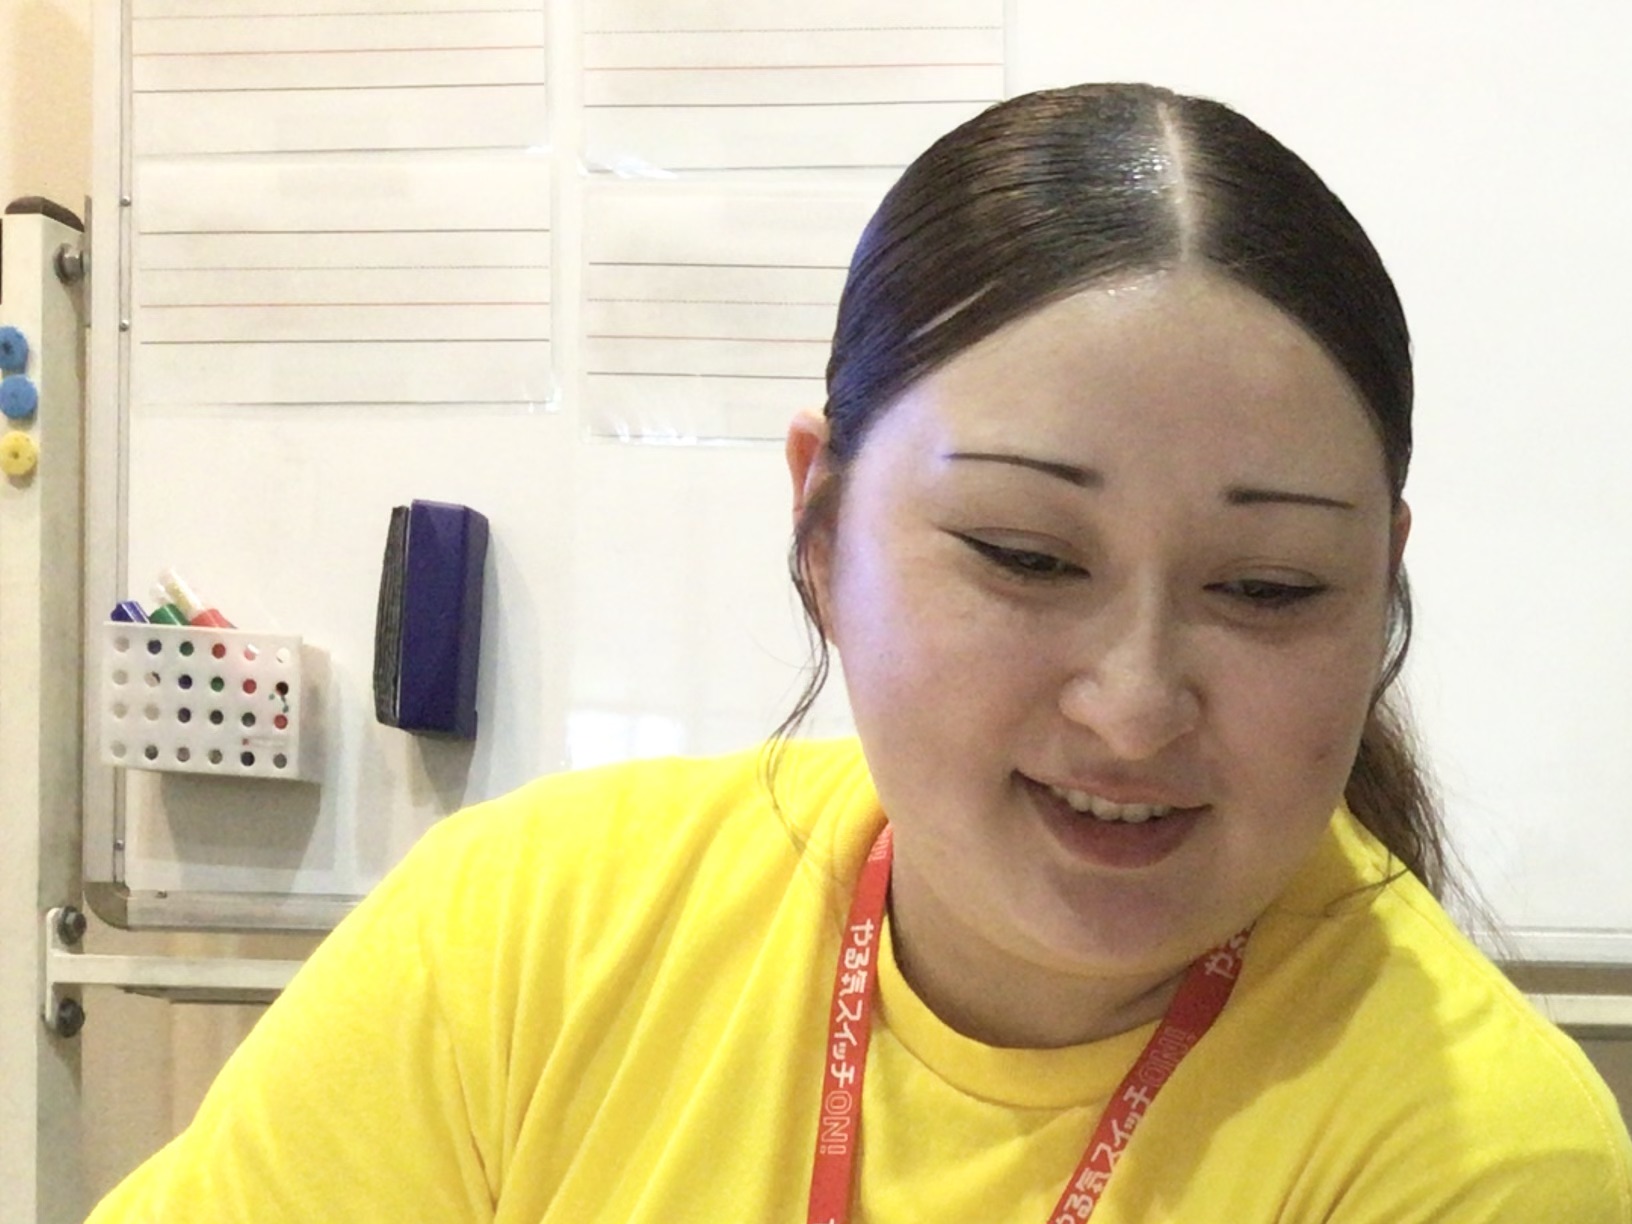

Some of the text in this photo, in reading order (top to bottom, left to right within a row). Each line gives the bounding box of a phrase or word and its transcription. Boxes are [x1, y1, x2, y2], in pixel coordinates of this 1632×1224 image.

[820, 918, 874, 1156] やる気スイッチON!
